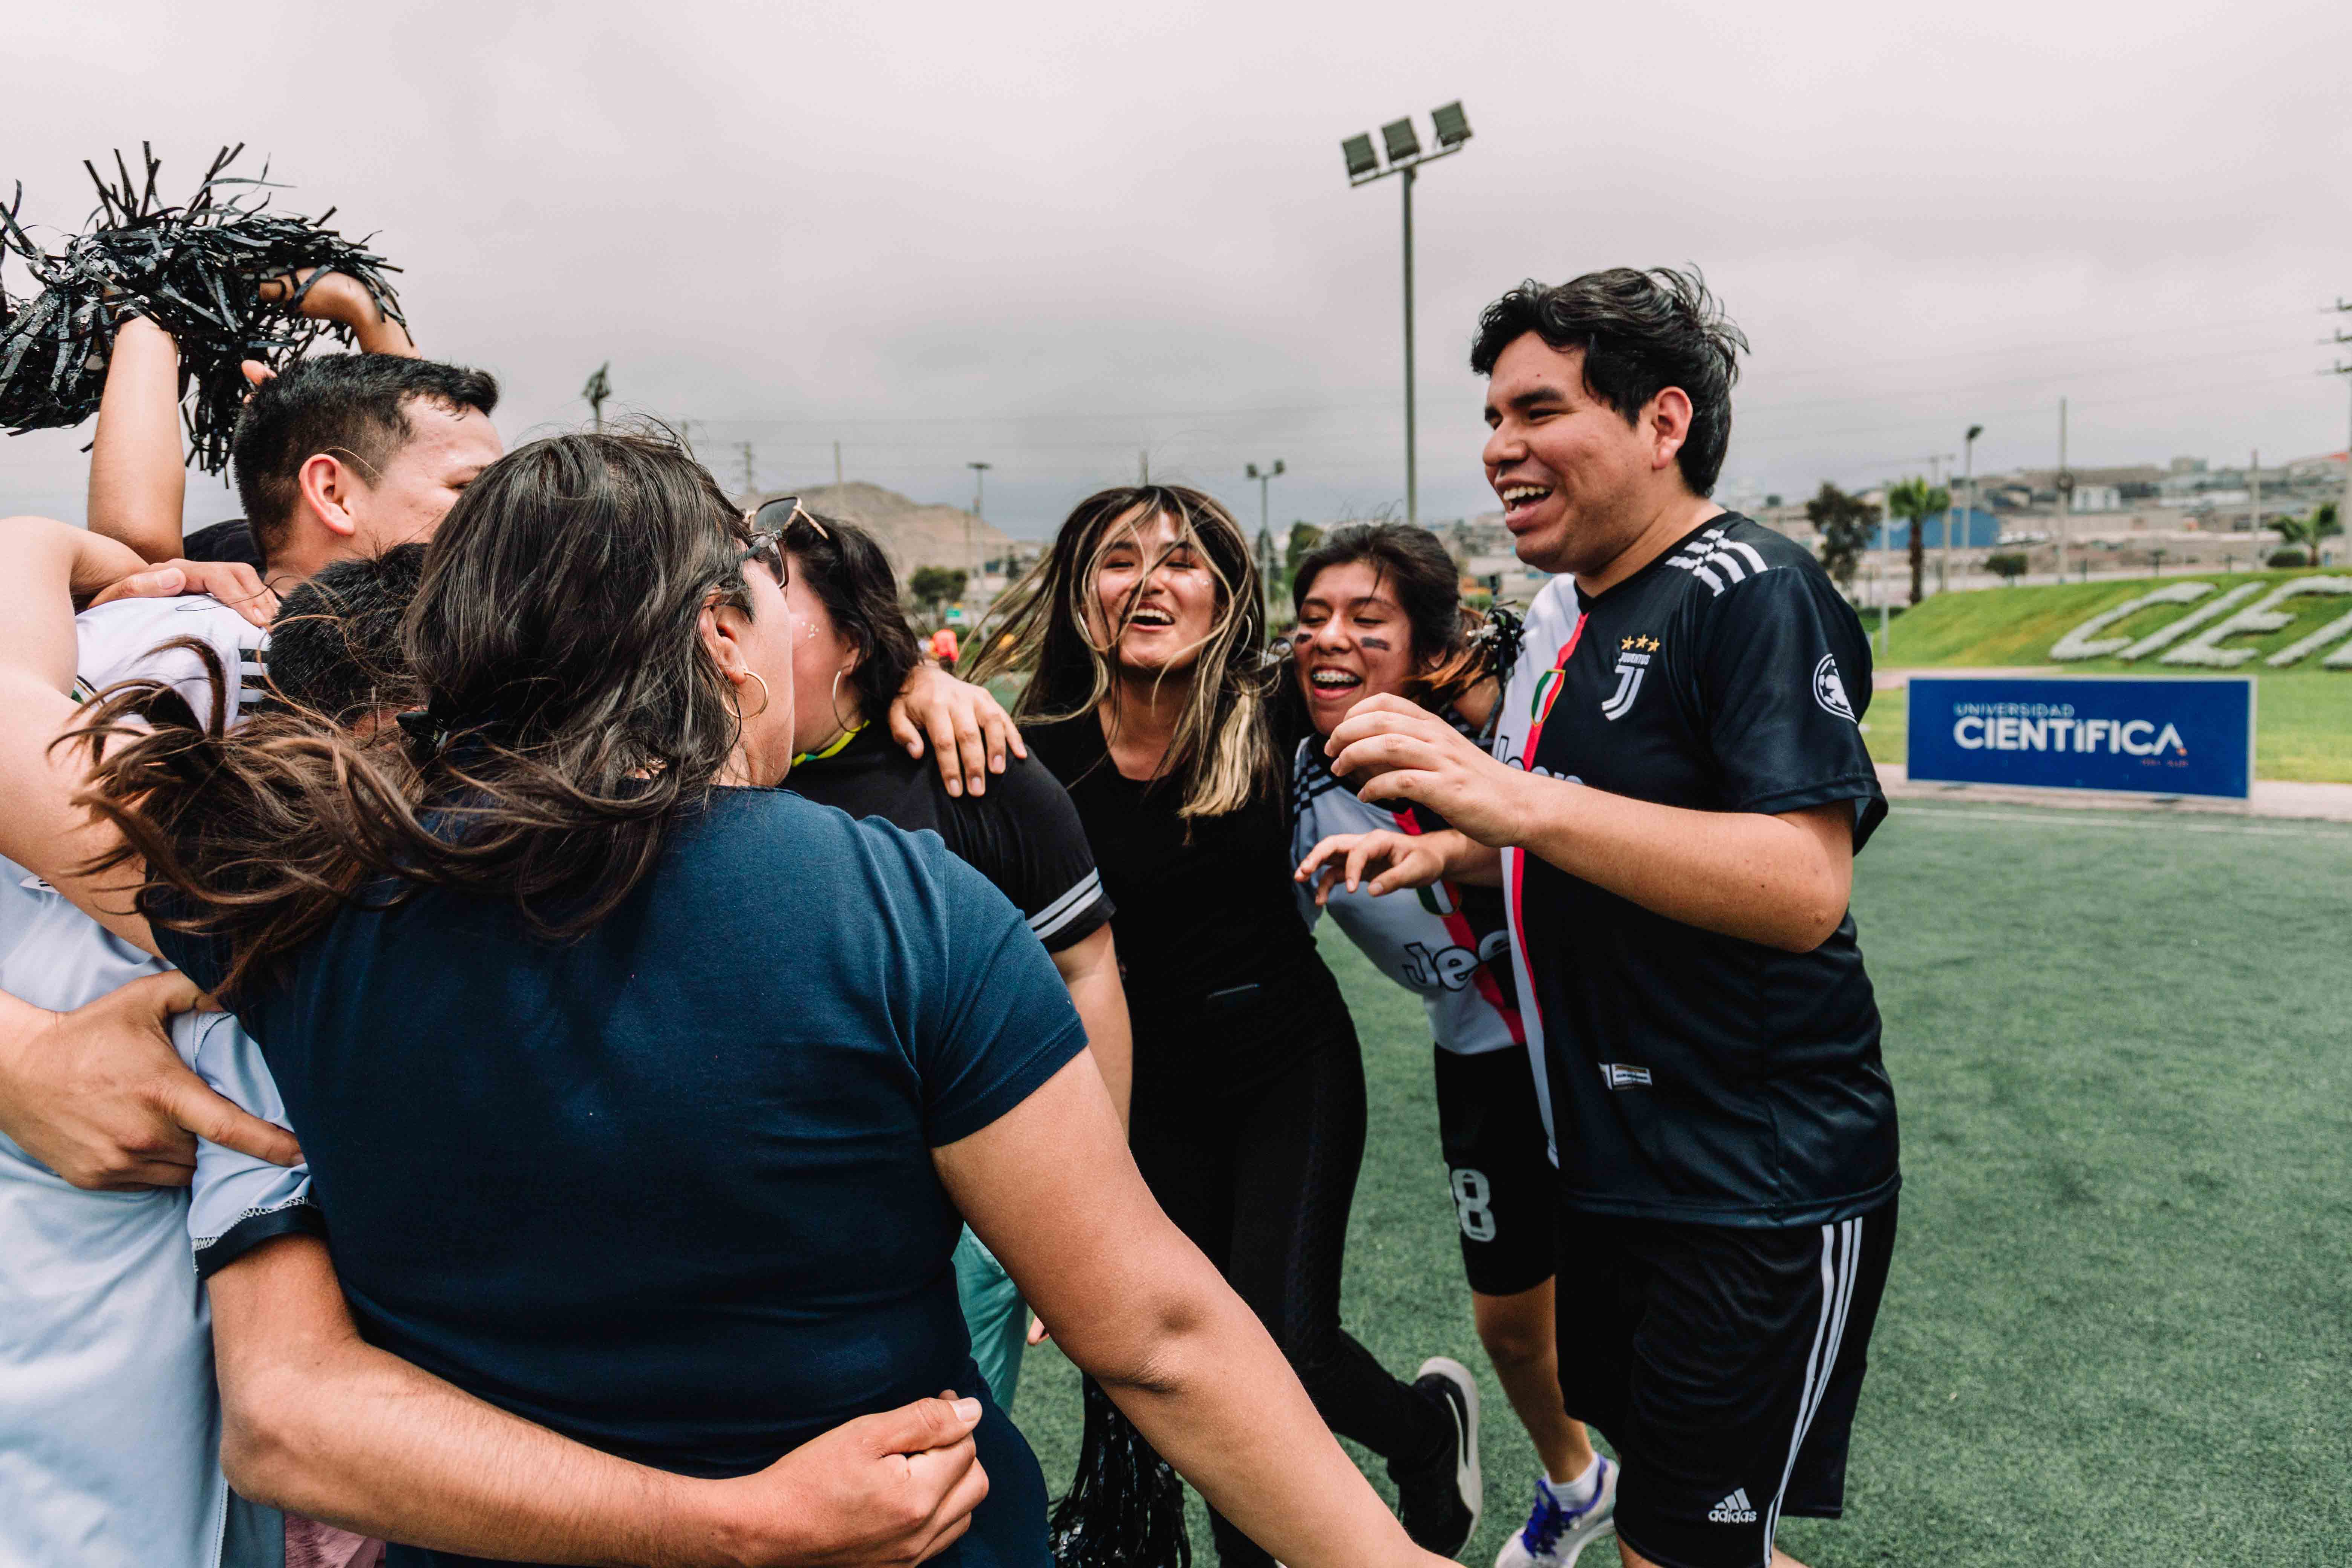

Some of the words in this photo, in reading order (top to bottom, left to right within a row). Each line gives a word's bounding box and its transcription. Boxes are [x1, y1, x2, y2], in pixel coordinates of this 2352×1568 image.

[1618, 652, 1651, 665] JUVENTUS
[1954, 703, 2075, 717] UNIVERSIDAD
[1708, 1508, 1757, 1524] adidas
